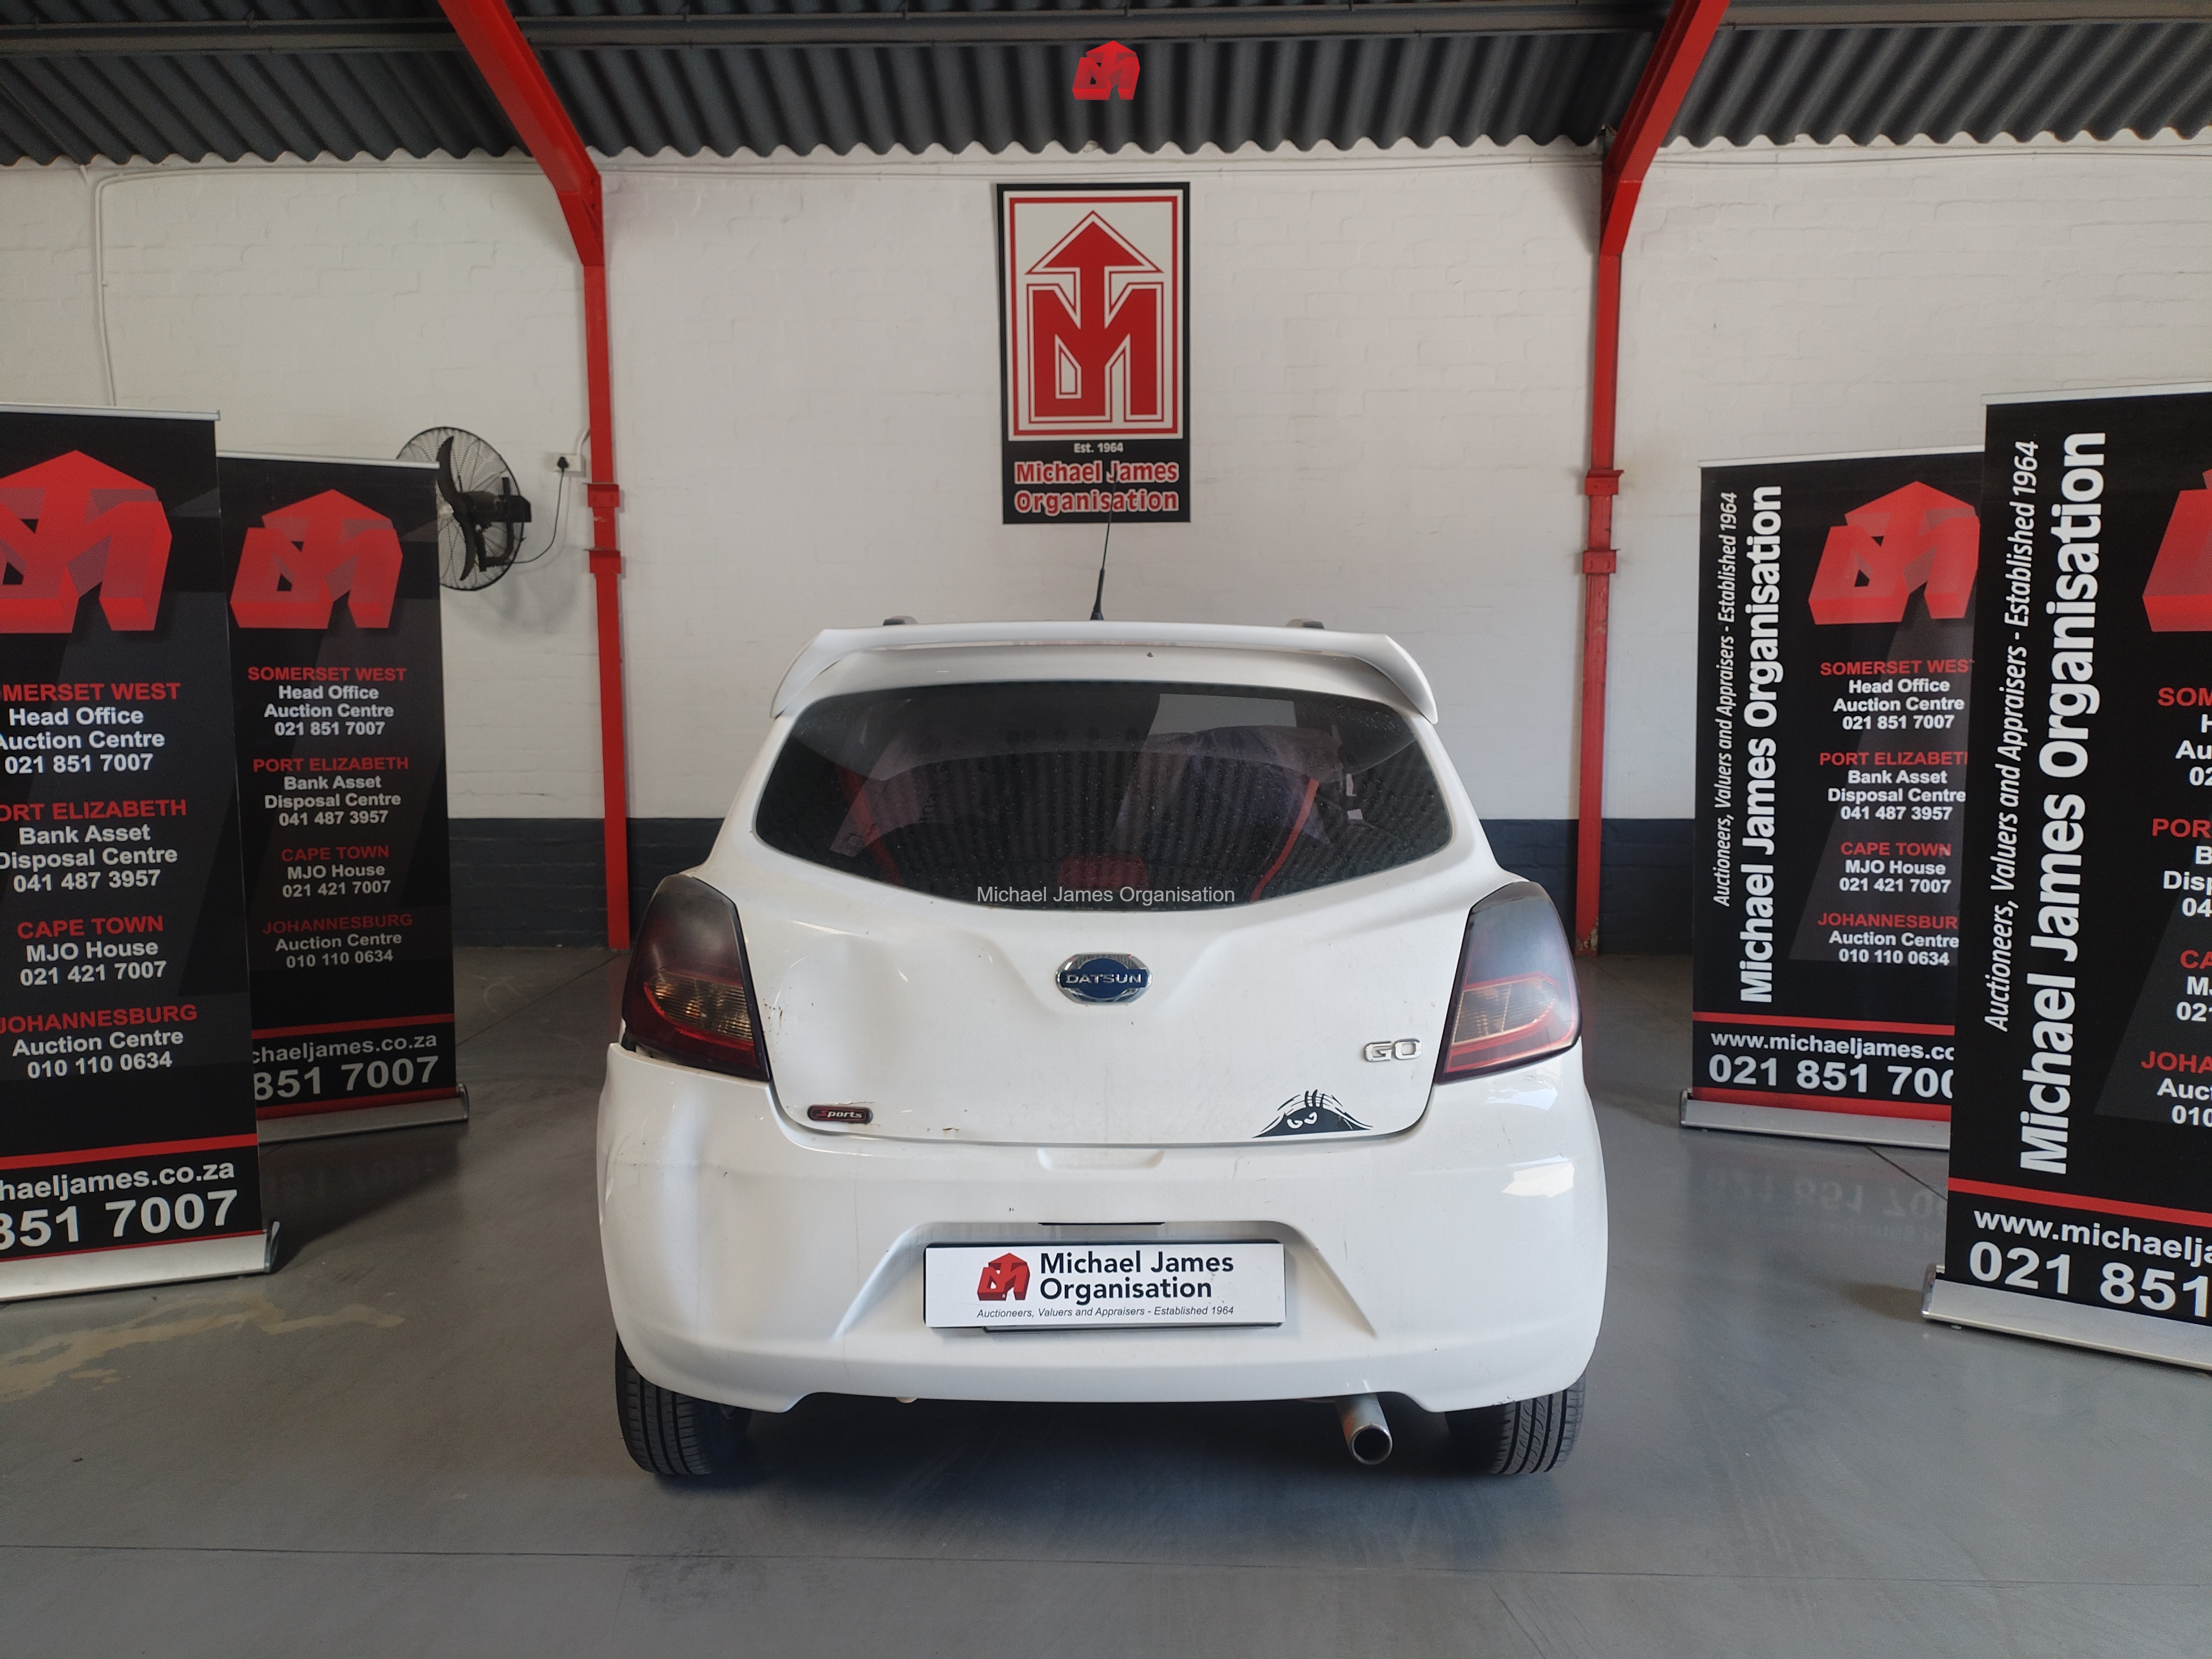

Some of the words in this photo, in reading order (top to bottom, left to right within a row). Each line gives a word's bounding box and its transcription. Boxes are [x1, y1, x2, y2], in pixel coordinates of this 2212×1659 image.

[1074, 443, 1094, 453] Est.
[1097, 442, 1123, 453] 1964
[1014, 461, 1103, 484] Michael
[1106, 461, 1179, 483] James
[2010, 441, 2039, 498] 1964
[1014, 489, 1179, 516] Organisation
[1721, 492, 1737, 532] 1964
[2005, 502, 2035, 627] Established
[1718, 535, 1737, 623] Established
[1744, 485, 1783, 727] Organisation
[2039, 433, 2106, 778] Organisation
[248, 667, 350, 681] SOMERSET
[355, 667, 407, 681] WEST
[1715, 635, 1737, 717] Appraisers
[1820, 660, 1923, 676] SOMERSET
[1927, 659, 1973, 673] WES
[0, 684, 104, 701] MERSET
[111, 683, 180, 700] WEST
[279, 685, 323, 699] Head
[328, 685, 379, 699] Office
[1849, 679, 1893, 693] Head
[1898, 678, 1950, 692] Office
[264, 703, 332, 717] Auction
[338, 703, 394, 717] Centre
[1833, 697, 1900, 711] Auction
[1906, 697, 1965, 710] Centre
[1998, 645, 2028, 761] Appraisers
[9, 707, 69, 726] Head
[76, 707, 144, 725] Office
[1843, 716, 1871, 730] 021
[1877, 716, 1906, 729] 851
[1913, 714, 1954, 729] 7007
[275, 721, 304, 736] 021
[311, 721, 339, 735] 851
[346, 721, 385, 735] 7007
[1717, 717, 1733, 750] and
[89, 731, 165, 748] Centre
[5, 756, 43, 774] 021
[53, 754, 91, 773] 851
[100, 753, 153, 771] 7007
[253, 758, 304, 772] PORT
[309, 757, 408, 771] ELIZABETH
[1820, 752, 1870, 765] PORT
[1874, 751, 1967, 765] ELIZABET
[284, 776, 328, 790] Bank
[333, 775, 381, 789] Asset
[1714, 752, 1732, 809] Valuers
[1848, 770, 1892, 784] Bank
[1896, 770, 1947, 784] Asset
[1995, 763, 2020, 807] and
[265, 793, 340, 811] Disposal
[346, 793, 401, 806] Centre
[1742, 738, 1777, 855] James
[1828, 788, 1903, 805] Disposal
[1908, 788, 1966, 802] Centre
[52, 799, 186, 819] ELIZABETH
[279, 812, 307, 826] 041
[314, 811, 344, 825] 487
[350, 810, 388, 824] 3957
[1841, 806, 1869, 819] 041
[1875, 806, 1906, 820] 487
[1911, 806, 1953, 820] 3957
[19, 826, 79, 845] Bank
[85, 824, 151, 842] Asset
[103, 847, 177, 865] Centre
[281, 847, 331, 861] CAPE
[336, 846, 389, 859] TOWN
[1841, 842, 1890, 855] CAPE
[1896, 842, 1951, 857] TOWN
[1990, 812, 2018, 891] Valuers
[1713, 813, 1735, 907] Auctioneers,
[1846, 860, 1884, 873] MJO
[1890, 860, 1946, 875] House
[14, 874, 51, 892] 041
[61, 872, 100, 889] 487
[109, 869, 160, 888] 3957
[288, 865, 326, 879] MJO
[332, 865, 385, 878] House
[2030, 794, 2086, 962] James
[282, 884, 310, 898] 021
[318, 882, 345, 895] 421
[353, 880, 391, 894] 7007
[1839, 878, 1867, 891] 021
[1874, 878, 1903, 892] 421
[1910, 879, 1951, 893] 7007
[17, 919, 84, 939] CAPE
[91, 915, 163, 934] TOWN
[262, 914, 412, 934] JOHANNESBURG
[1739, 864, 1775, 1003] Michael
[275, 936, 341, 951] Auction
[347, 933, 402, 946] Centre
[1829, 930, 1896, 945] Auction
[1901, 933, 1959, 948] Centre
[26, 943, 78, 962] MJO
[86, 941, 158, 958] House
[287, 954, 315, 968] 010
[322, 952, 349, 965] 110
[355, 949, 393, 963] 0634
[1839, 948, 1869, 962] 010
[1874, 949, 1903, 963] 110
[1908, 951, 1950, 966] 0634
[21, 967, 58, 986] 021
[68, 964, 105, 982] 421
[114, 961, 166, 979] 7007
[1984, 900, 2019, 1032] Auctioneers,
[1066, 974, 1141, 983] DATSUN
[13, 1036, 102, 1056] Auction
[110, 1030, 183, 1048] Centre
[1364, 1038, 1422, 1062] GO
[28, 1060, 67, 1078] 010
[76, 1056, 112, 1074] 110
[120, 1051, 172, 1070] 0634
[1709, 1054, 1776, 1085] 021
[1797, 1060, 1867, 1092] 851
[2020, 973, 2076, 1174] Michael
[253, 1067, 320, 1100] 851
[341, 1056, 438, 1090] 7007
[104, 1189, 238, 1239] 7007
[1041, 1250, 1141, 1274] Michael
[1151, 1251, 1234, 1273] James
[1970, 1241, 2071, 1295] 021
[2100, 1263, 2209, 1318] 851
[1040, 1276, 1211, 1305] Organisation
[977, 1309, 1034, 1319] Auctioneers,
[1038, 1308, 1073, 1317] Valuers
[1075, 1308, 1093, 1317] and
[1095, 1307, 1145, 1318] Appraisers
[1154, 1306, 1208, 1315] Established
[1211, 1306, 1234, 1315] 1964
